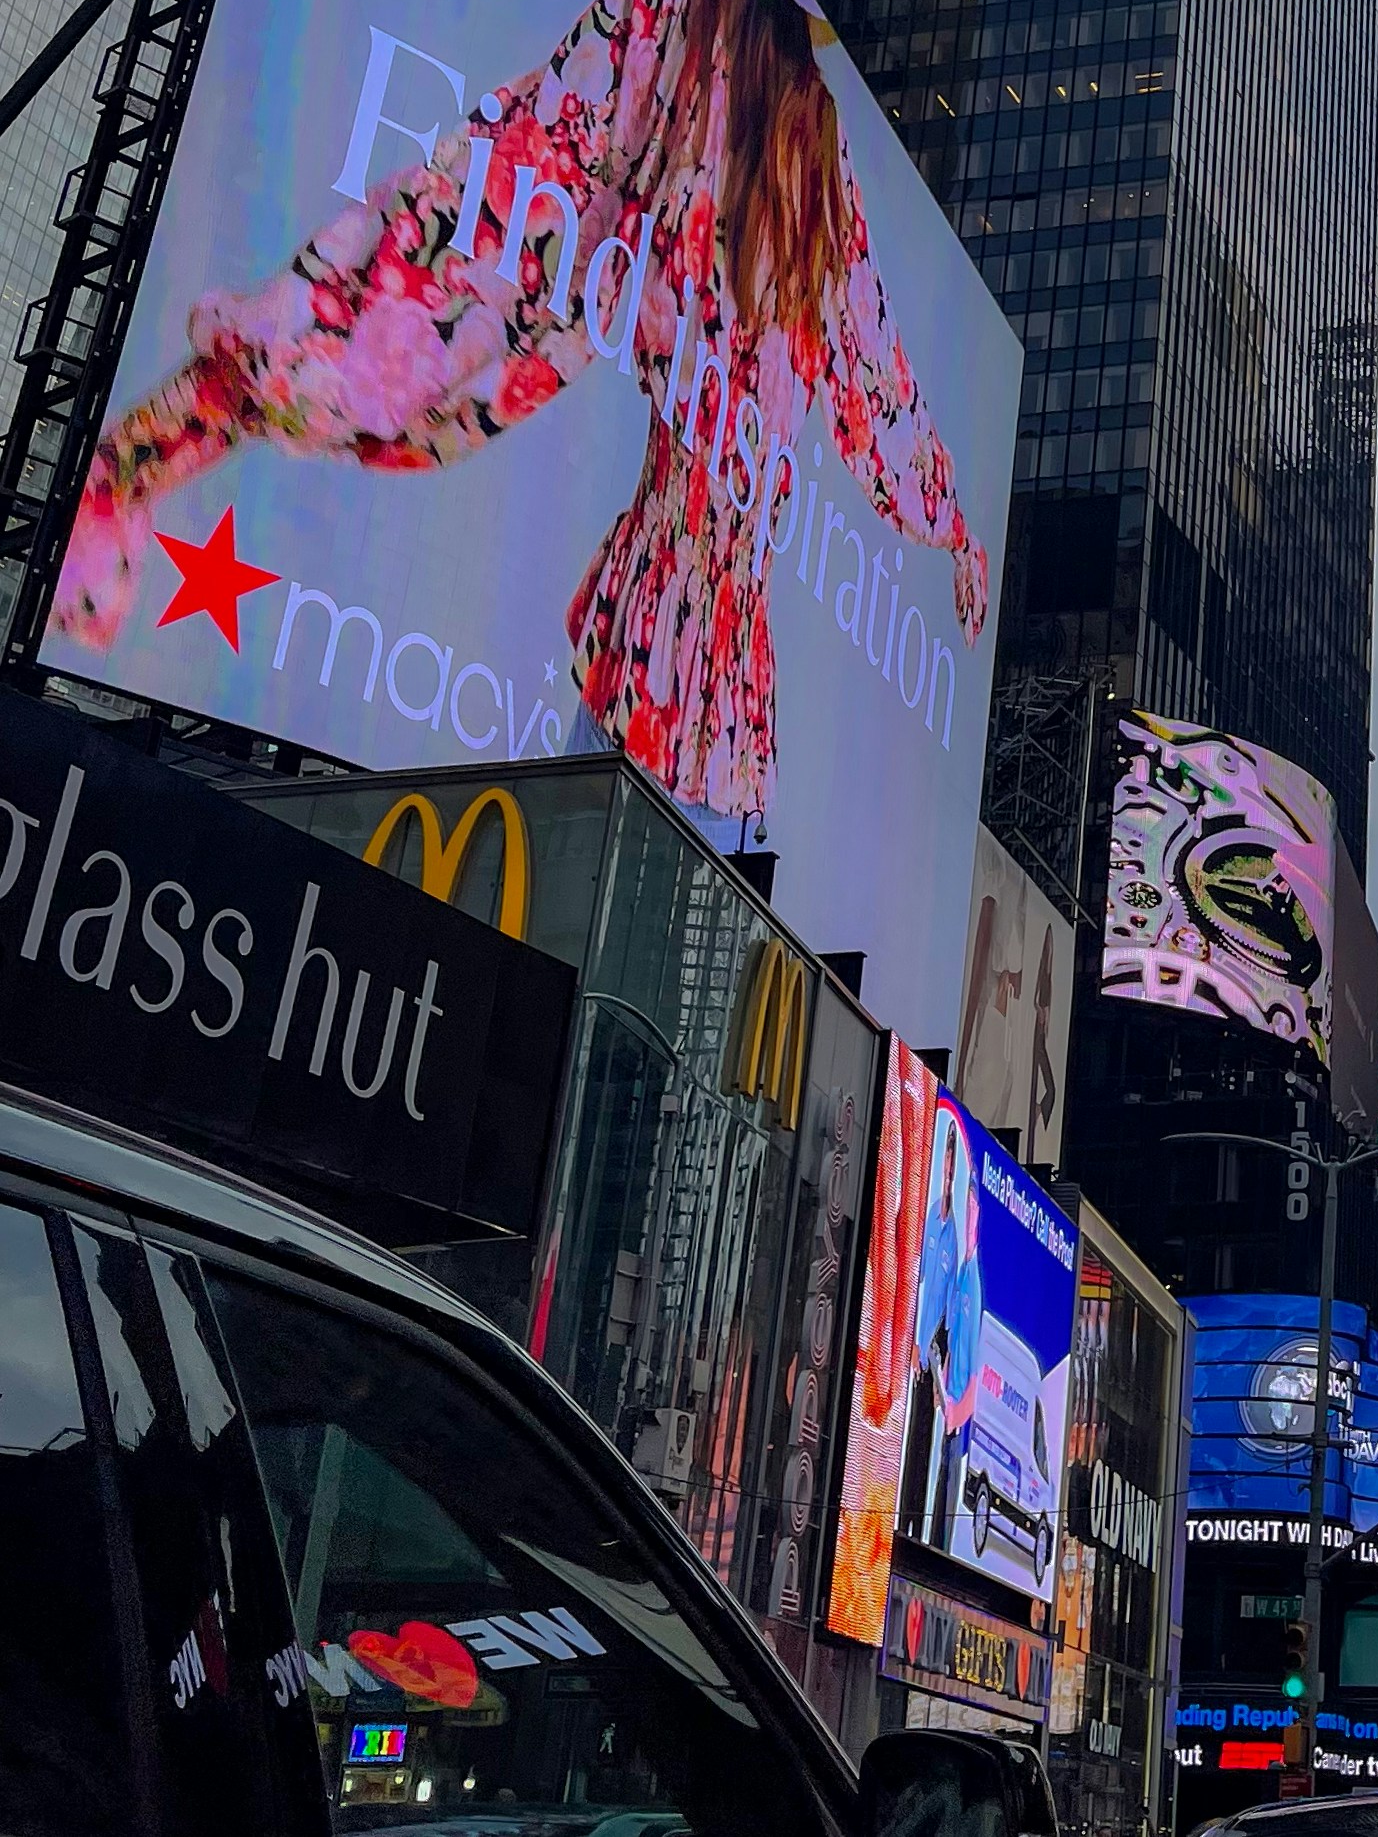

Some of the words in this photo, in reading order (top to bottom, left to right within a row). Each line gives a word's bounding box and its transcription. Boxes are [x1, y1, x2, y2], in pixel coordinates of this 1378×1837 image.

[330, 24, 656, 373] Find
[662, 276, 960, 752] inspiration
[268, 882, 443, 1121] hut
[1287, 1101, 1310, 1221] 1500
[1091, 1459, 1122, 1549] OLD
[1122, 1480, 1162, 1573] NAVY
[1186, 1520, 1283, 1542] TONIGHT
[1287, 1523, 1332, 1546] WIH
[1256, 1598, 1268, 1616] W
[955, 1620, 1007, 1693] GIFTS
[1354, 1721, 1378, 1739] on
